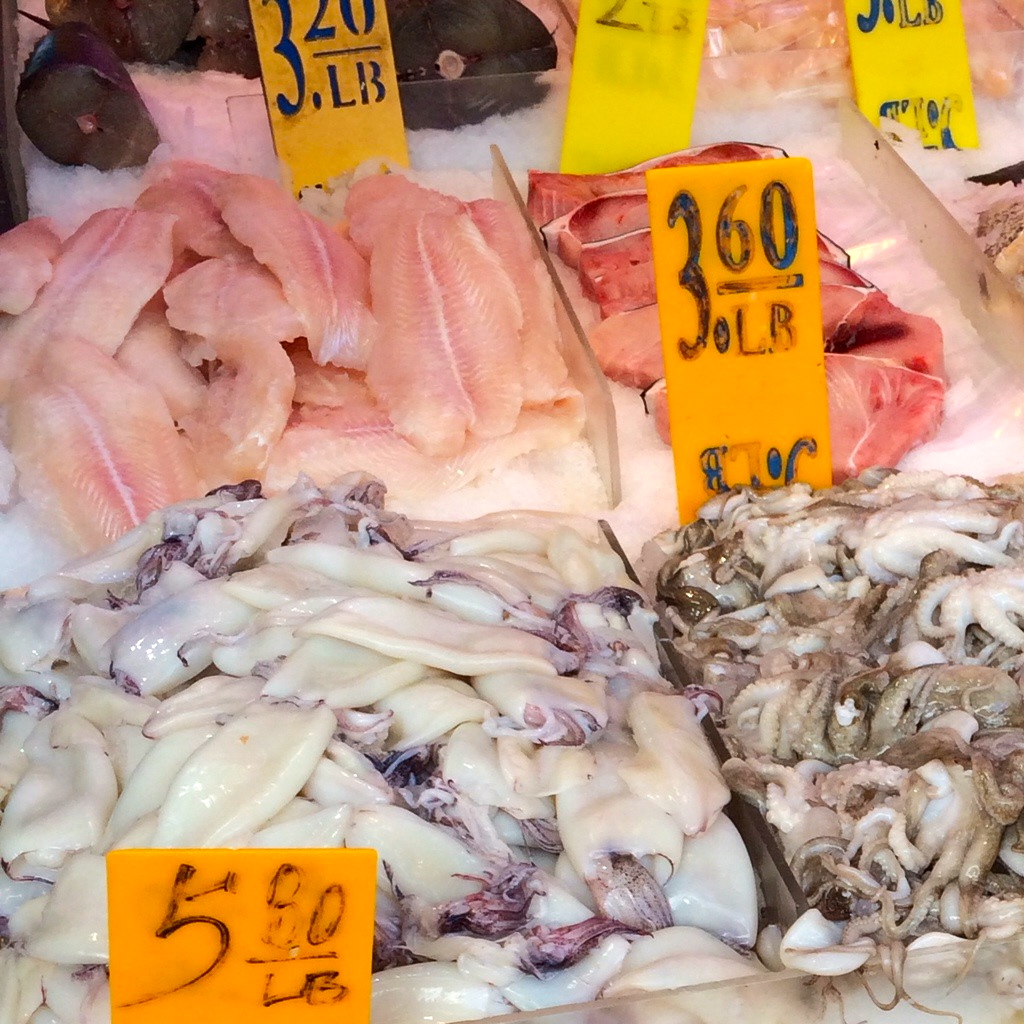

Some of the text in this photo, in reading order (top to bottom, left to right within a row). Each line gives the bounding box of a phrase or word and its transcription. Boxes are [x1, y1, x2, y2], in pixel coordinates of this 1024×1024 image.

[326, 61, 386, 108] LB
[716, 180, 799, 271] 60
[118, 864, 237, 1008] 5
